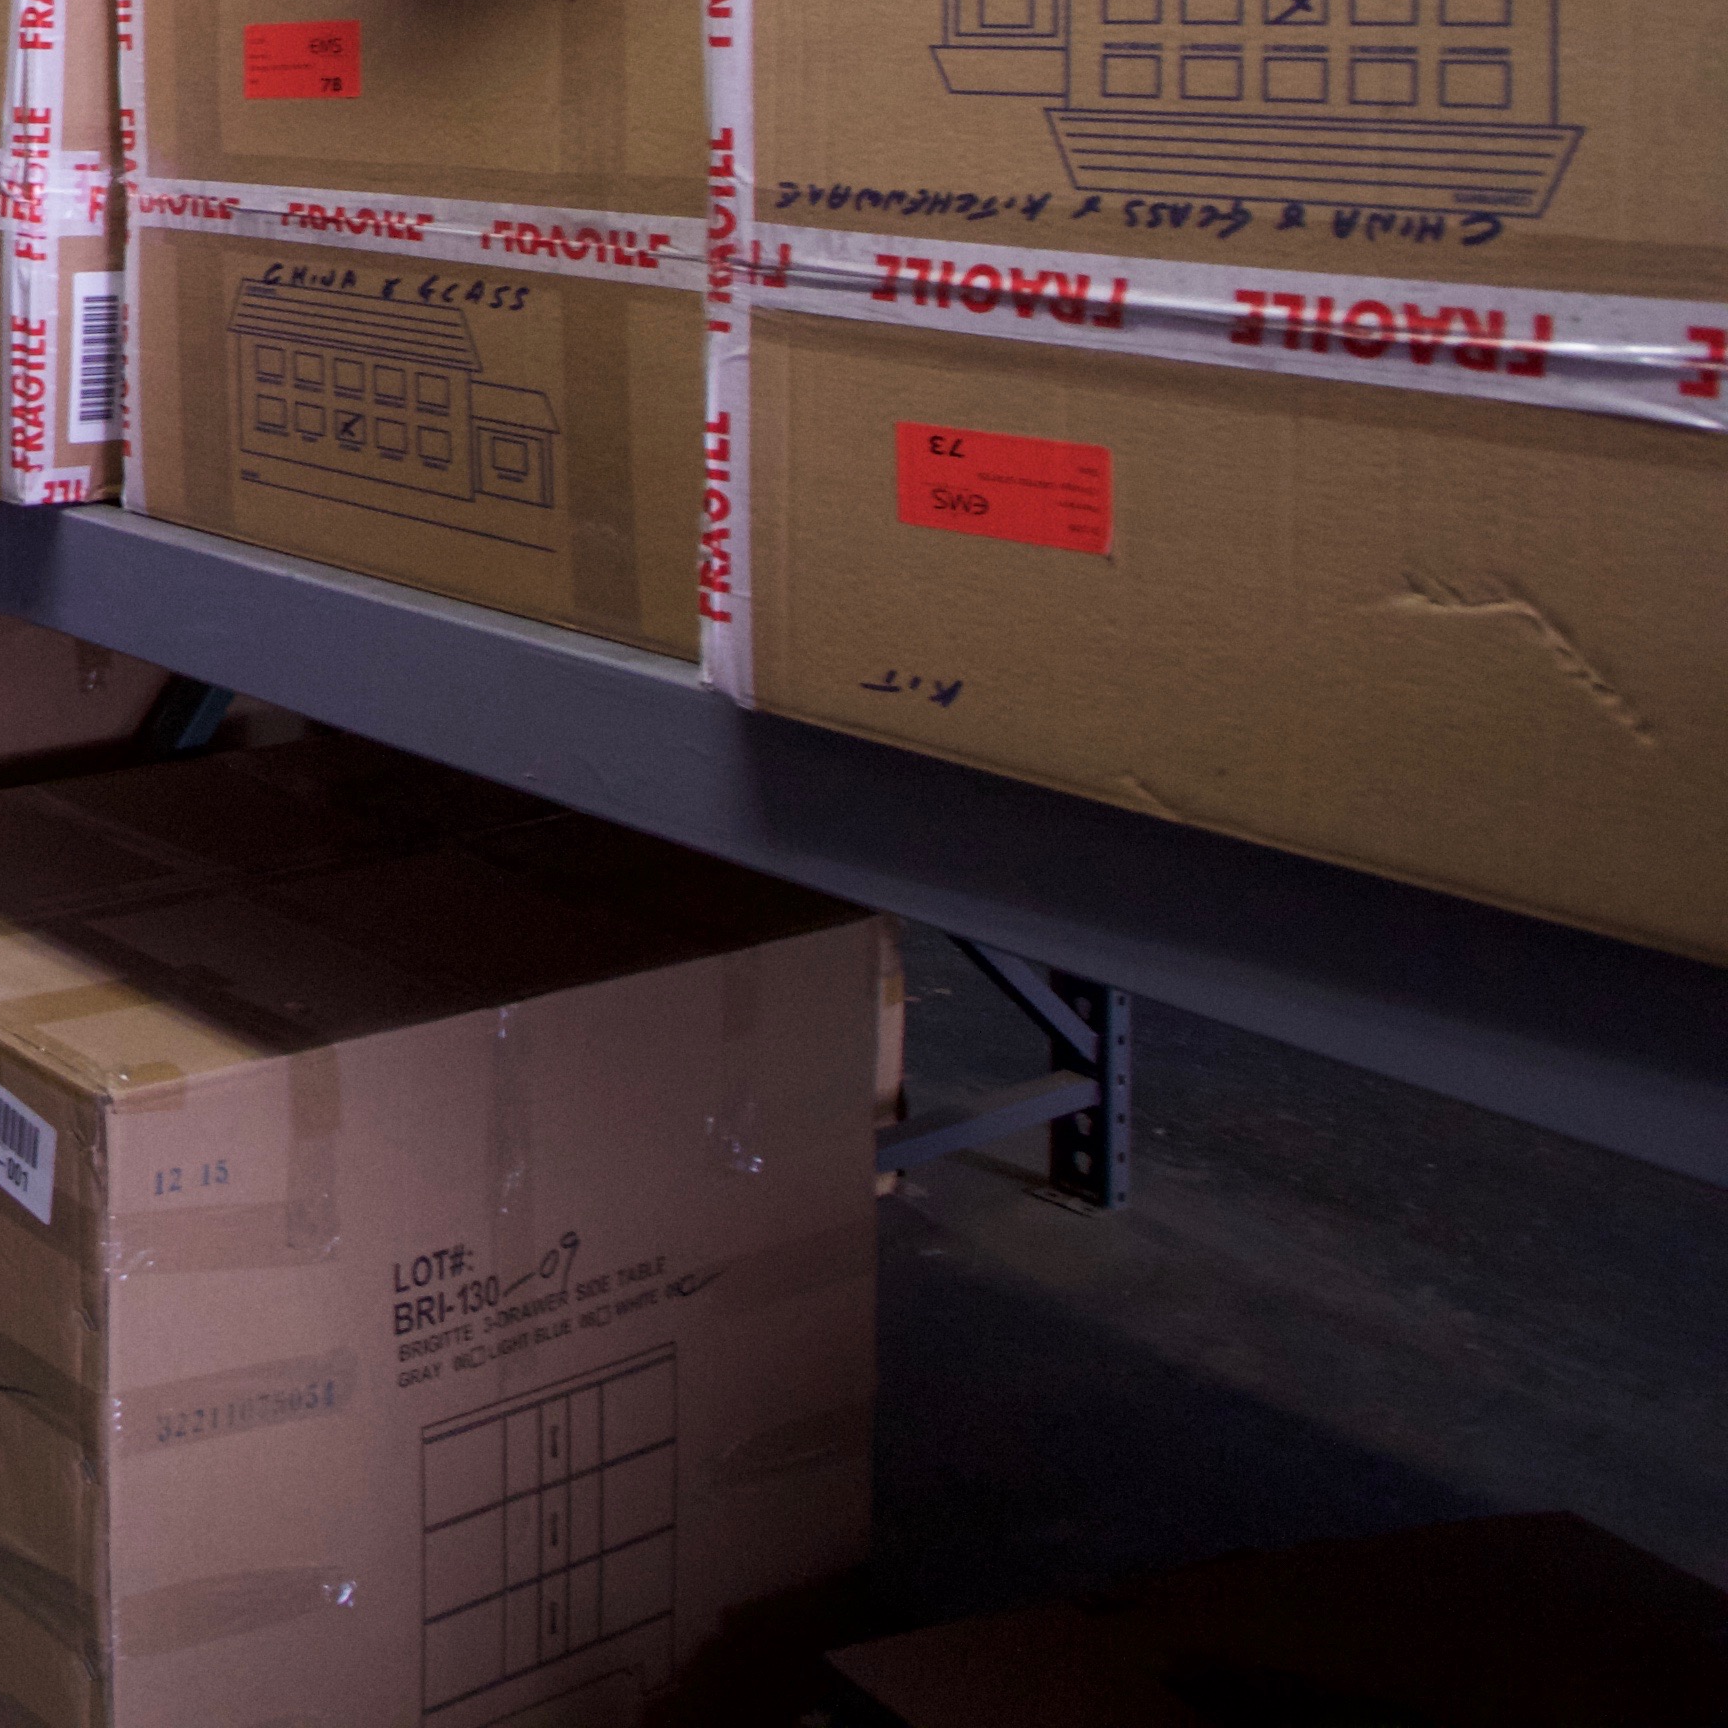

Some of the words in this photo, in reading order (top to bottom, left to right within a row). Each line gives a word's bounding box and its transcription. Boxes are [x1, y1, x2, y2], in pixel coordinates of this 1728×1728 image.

[280, 201, 435, 243] FRAGILE
[1121, 196, 1255, 235] GLASS
[1330, 206, 1504, 249] CHINA
[480, 219, 672, 270] FRAGILE
[260, 262, 358, 292] CHINA
[416, 276, 532, 311] GLASS
[871, 251, 1130, 331] FRAGILE
[1227, 285, 1554, 380] FRAGILE
[10, 315, 48, 473] FRAGILE
[928, 432, 966, 459] 73
[861, 668, 965, 709] KIT
[151, 1167, 183, 1198] 12
[199, 1159, 231, 1188] 15
[392, 1241, 476, 1295] LOT#:
[393, 1273, 500, 1336] BRI-130
[396, 1320, 476, 1364] BRIGITTE
[481, 1288, 570, 1336] 3-DRAWER
[575, 1276, 614, 1306] SIDE
[615, 1254, 669, 1295] TABLE
[396, 1357, 445, 1388] GRAY
[534, 1322, 574, 1350] BLUE
